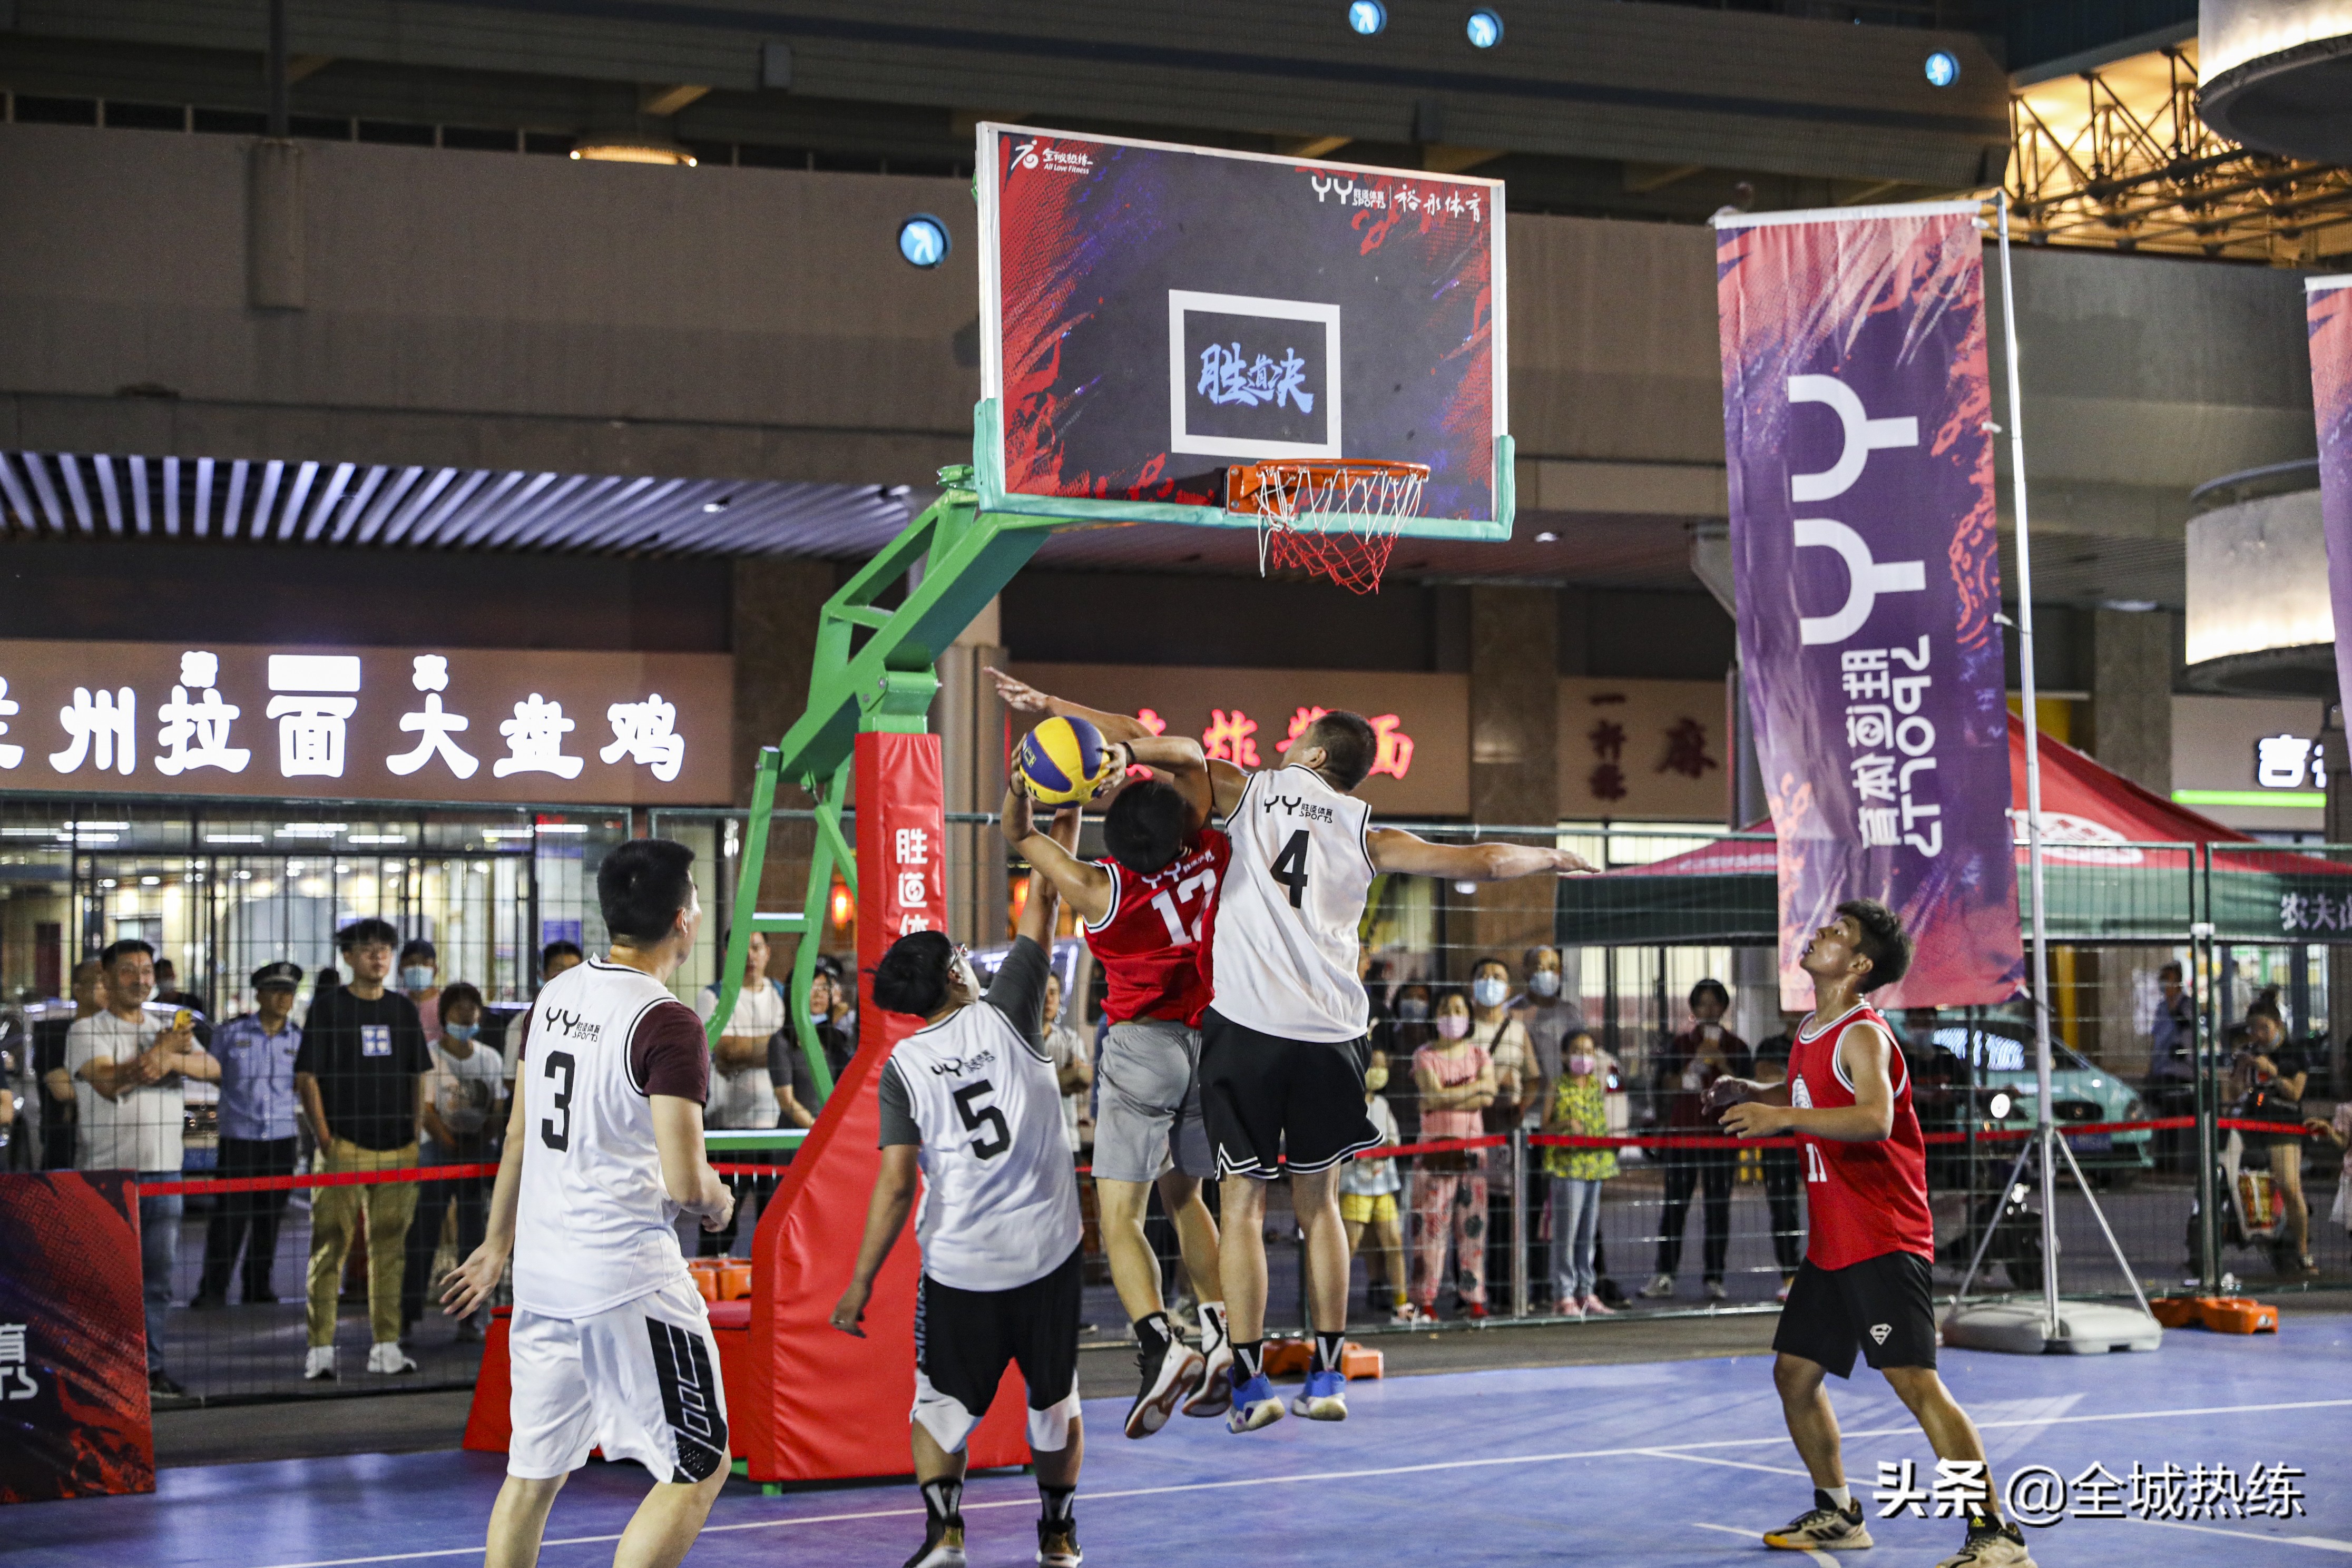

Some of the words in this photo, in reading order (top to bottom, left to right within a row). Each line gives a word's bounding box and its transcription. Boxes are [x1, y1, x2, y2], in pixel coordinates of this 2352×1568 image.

[1054, 164, 1067, 172] Love
[1068, 165, 1090, 174] Fitness
[1352, 198, 1386, 209] SPORTS
[0, 675, 685, 782] 州拉面大盘鸡
[1890, 634, 1943, 858] SPORTS
[1299, 811, 1333, 824] SPORTS
[1301, 803, 1333, 817] 胜道体育
[1269, 829, 1310, 909] 4
[572, 1031, 599, 1043] SPORTS
[541, 1050, 575, 1153] 3
[953, 1079, 1011, 1161] 5
